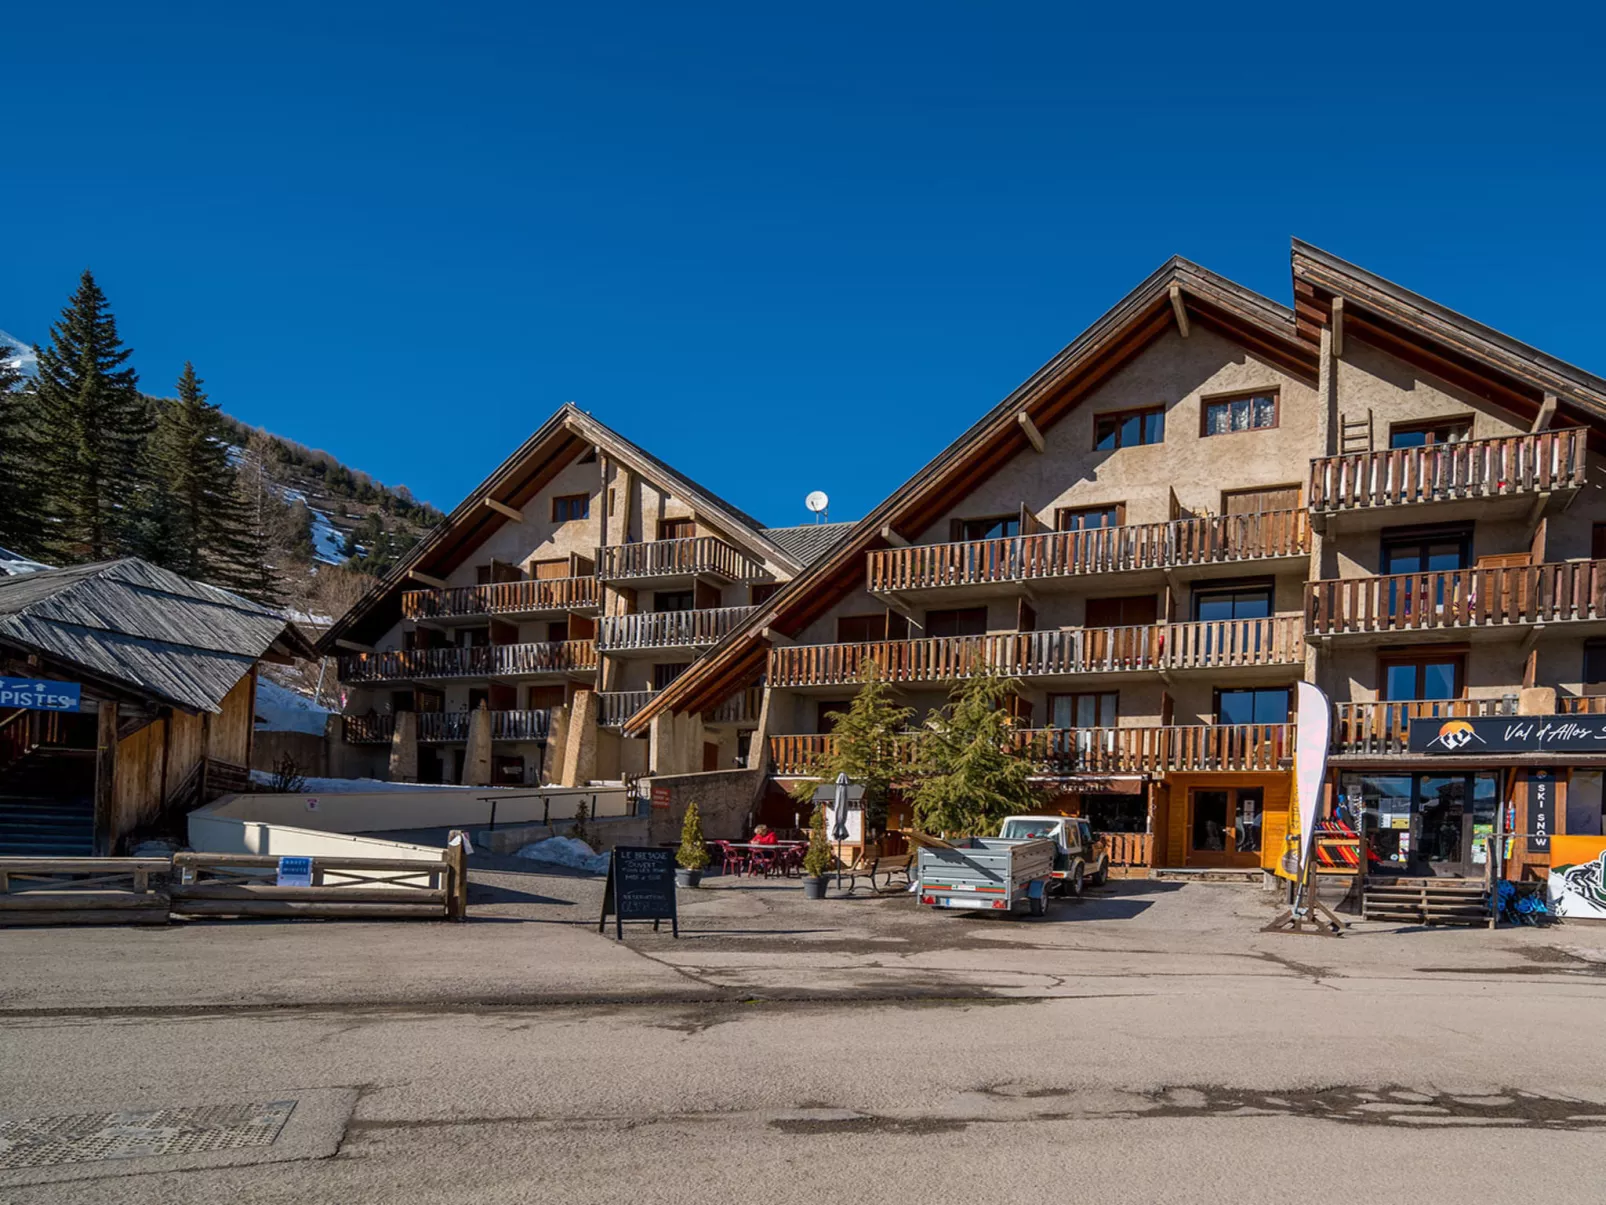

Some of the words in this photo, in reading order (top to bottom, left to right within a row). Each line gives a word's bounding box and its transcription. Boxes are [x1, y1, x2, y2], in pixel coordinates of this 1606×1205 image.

[1, 691, 70, 708] PISTES
[1504, 722, 1534, 741] Val
[1536, 723, 1593, 742] d'Allos
[1537, 784, 1546, 808] SKI
[1535, 814, 1547, 846] SNOW
